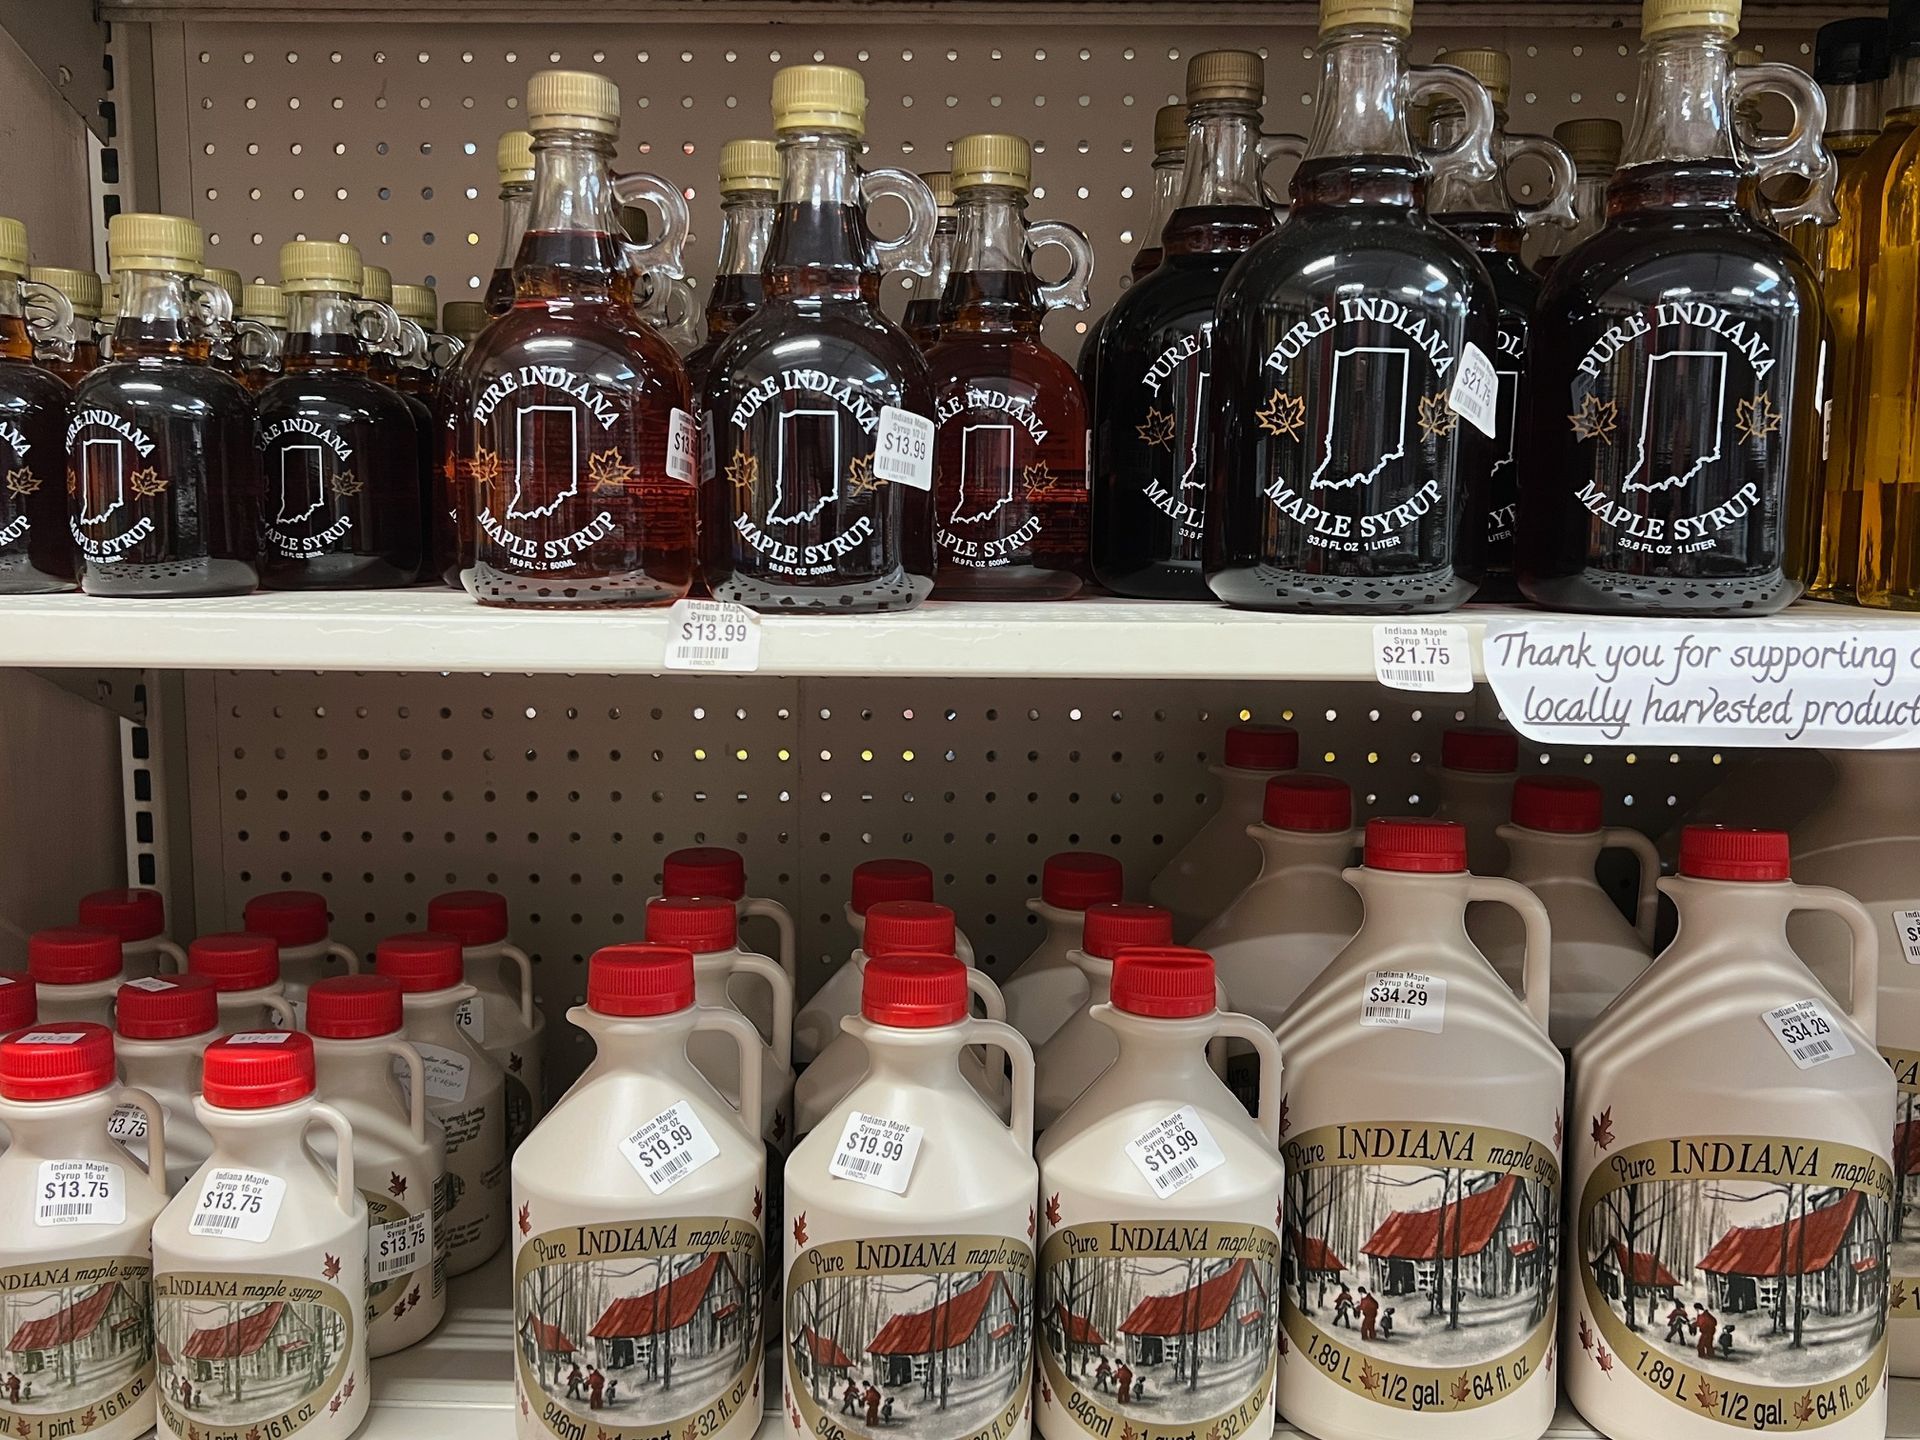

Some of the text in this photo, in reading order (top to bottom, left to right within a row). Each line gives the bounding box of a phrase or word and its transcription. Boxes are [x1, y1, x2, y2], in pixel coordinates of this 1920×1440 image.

[1266, 306, 1337, 375] PURE
[1340, 298, 1454, 378] INDIANA
[1578, 311, 1651, 379] PURE
[1654, 302, 1776, 380] INDIANA
[1142, 334, 1201, 398] PURE
[474, 365, 620, 430] PURE INDIANA
[731, 369, 880, 434] PURE INDIANA
[82, 410, 155, 458] INDIANA
[968, 390, 1048, 446] INDIANA
[281, 418, 352, 461] INDIANA
[885, 432, 925, 460] $13.99
[1263, 476, 1351, 538] MAPLE
[1360, 480, 1442, 538] SYRUP
[1574, 480, 1664, 540] MAPLE
[1674, 482, 1760, 540] SYRUP
[102, 517, 155, 554] SYRUP
[302, 516, 352, 550] SYRUP
[478, 506, 537, 558] MAPLE
[545, 511, 616, 558] SYRUP
[733, 512, 798, 563] MAPLE
[804, 516, 874, 564] SYRUP
[984, 516, 1042, 559] SYRUP
[1307, 534, 1326, 548] 33.8
[1329, 539, 1342, 550] FL
[1343, 540, 1358, 552] OZ
[1371, 536, 1401, 550] LITER
[1618, 537, 1639, 551] 33.8
[1641, 542, 1655, 553] FL
[1656, 544, 1672, 554] OZ
[1685, 539, 1717, 553] LITER
[688, 601, 720, 610] Indiana
[691, 612, 716, 622] Syrup
[721, 614, 734, 622] 1/2
[682, 622, 746, 642] $13.99
[1385, 627, 1447, 637] Indiana Maple
[1394, 637, 1420, 646] Syrup
[1383, 646, 1450, 664] $21.75
[1494, 632, 1596, 668] Thank
[1595, 644, 1664, 682] you
[1655, 634, 1721, 685] for
[1730, 638, 1896, 686] supporting
[1524, 686, 1632, 740] locally
[1643, 684, 1792, 725] harvested
[1406, 972, 1430, 982] Maple
[1370, 987, 1427, 1006] $34.29
[1782, 1017, 1830, 1044] $34.29
[629, 1108, 677, 1144] Indiana Maple
[638, 1131, 660, 1149] Syrup
[660, 1124, 670, 1134] 32
[860, 1113, 910, 1133] Indiana Maple
[860, 1124, 904, 1142] Syrup 32 OZ
[1135, 1113, 1183, 1147] Indiana Maple
[1143, 1136, 1166, 1152] Syrup
[1164, 1129, 1175, 1139] 32
[639, 1125, 692, 1167] $19.99
[847, 1132, 903, 1161] $19.99
[1145, 1130, 1198, 1171] $19.99
[1288, 1125, 1534, 1175] Pure INDIANA maple
[51, 1163, 109, 1172] Indiana Maple
[84, 1172, 94, 1180] 16
[216, 1172, 269, 1185] Indiana Maple
[1611, 1140, 1875, 1190] Pure INDIANA maple
[45, 1181, 109, 1200] $13.75
[204, 1191, 262, 1213] $13.75
[216, 1182, 250, 1192] Syrup 16
[380, 1228, 425, 1256] $13.75
[533, 1220, 730, 1262] Pure INDIANA maple
[808, 1239, 1006, 1274] Pure INDIANA maple
[1062, 1222, 1257, 1260] Pure INDIANA maple
[75, 1260, 118, 1282] maple
[169, 1276, 237, 1296] INDIANA
[242, 1280, 286, 1300] maple
[289, 1289, 322, 1302] syrup
[1306, 1334, 1530, 1412] 1.89 L 1/2 gal. 64 fl. oz
[49, 1420, 75, 1439] pint
[99, 1400, 117, 1420] 16
[117, 1392, 131, 1408] fl.
[132, 1378, 147, 1396] oz
[1636, 1351, 1870, 1431] 1.89 L 1/2 gal. 64 fl. oz
[263, 1422, 281, 1440] 16
[282, 1413, 297, 1432] fl.
[298, 1403, 316, 1420] oz
[543, 1381, 747, 1440] 946ml 32 fl. oz
[1006, 1403, 1019, 1428] oz
[1067, 1392, 1114, 1438] 946ml
[1220, 1413, 1240, 1440] 32
[1240, 1406, 1252, 1425] fl.
